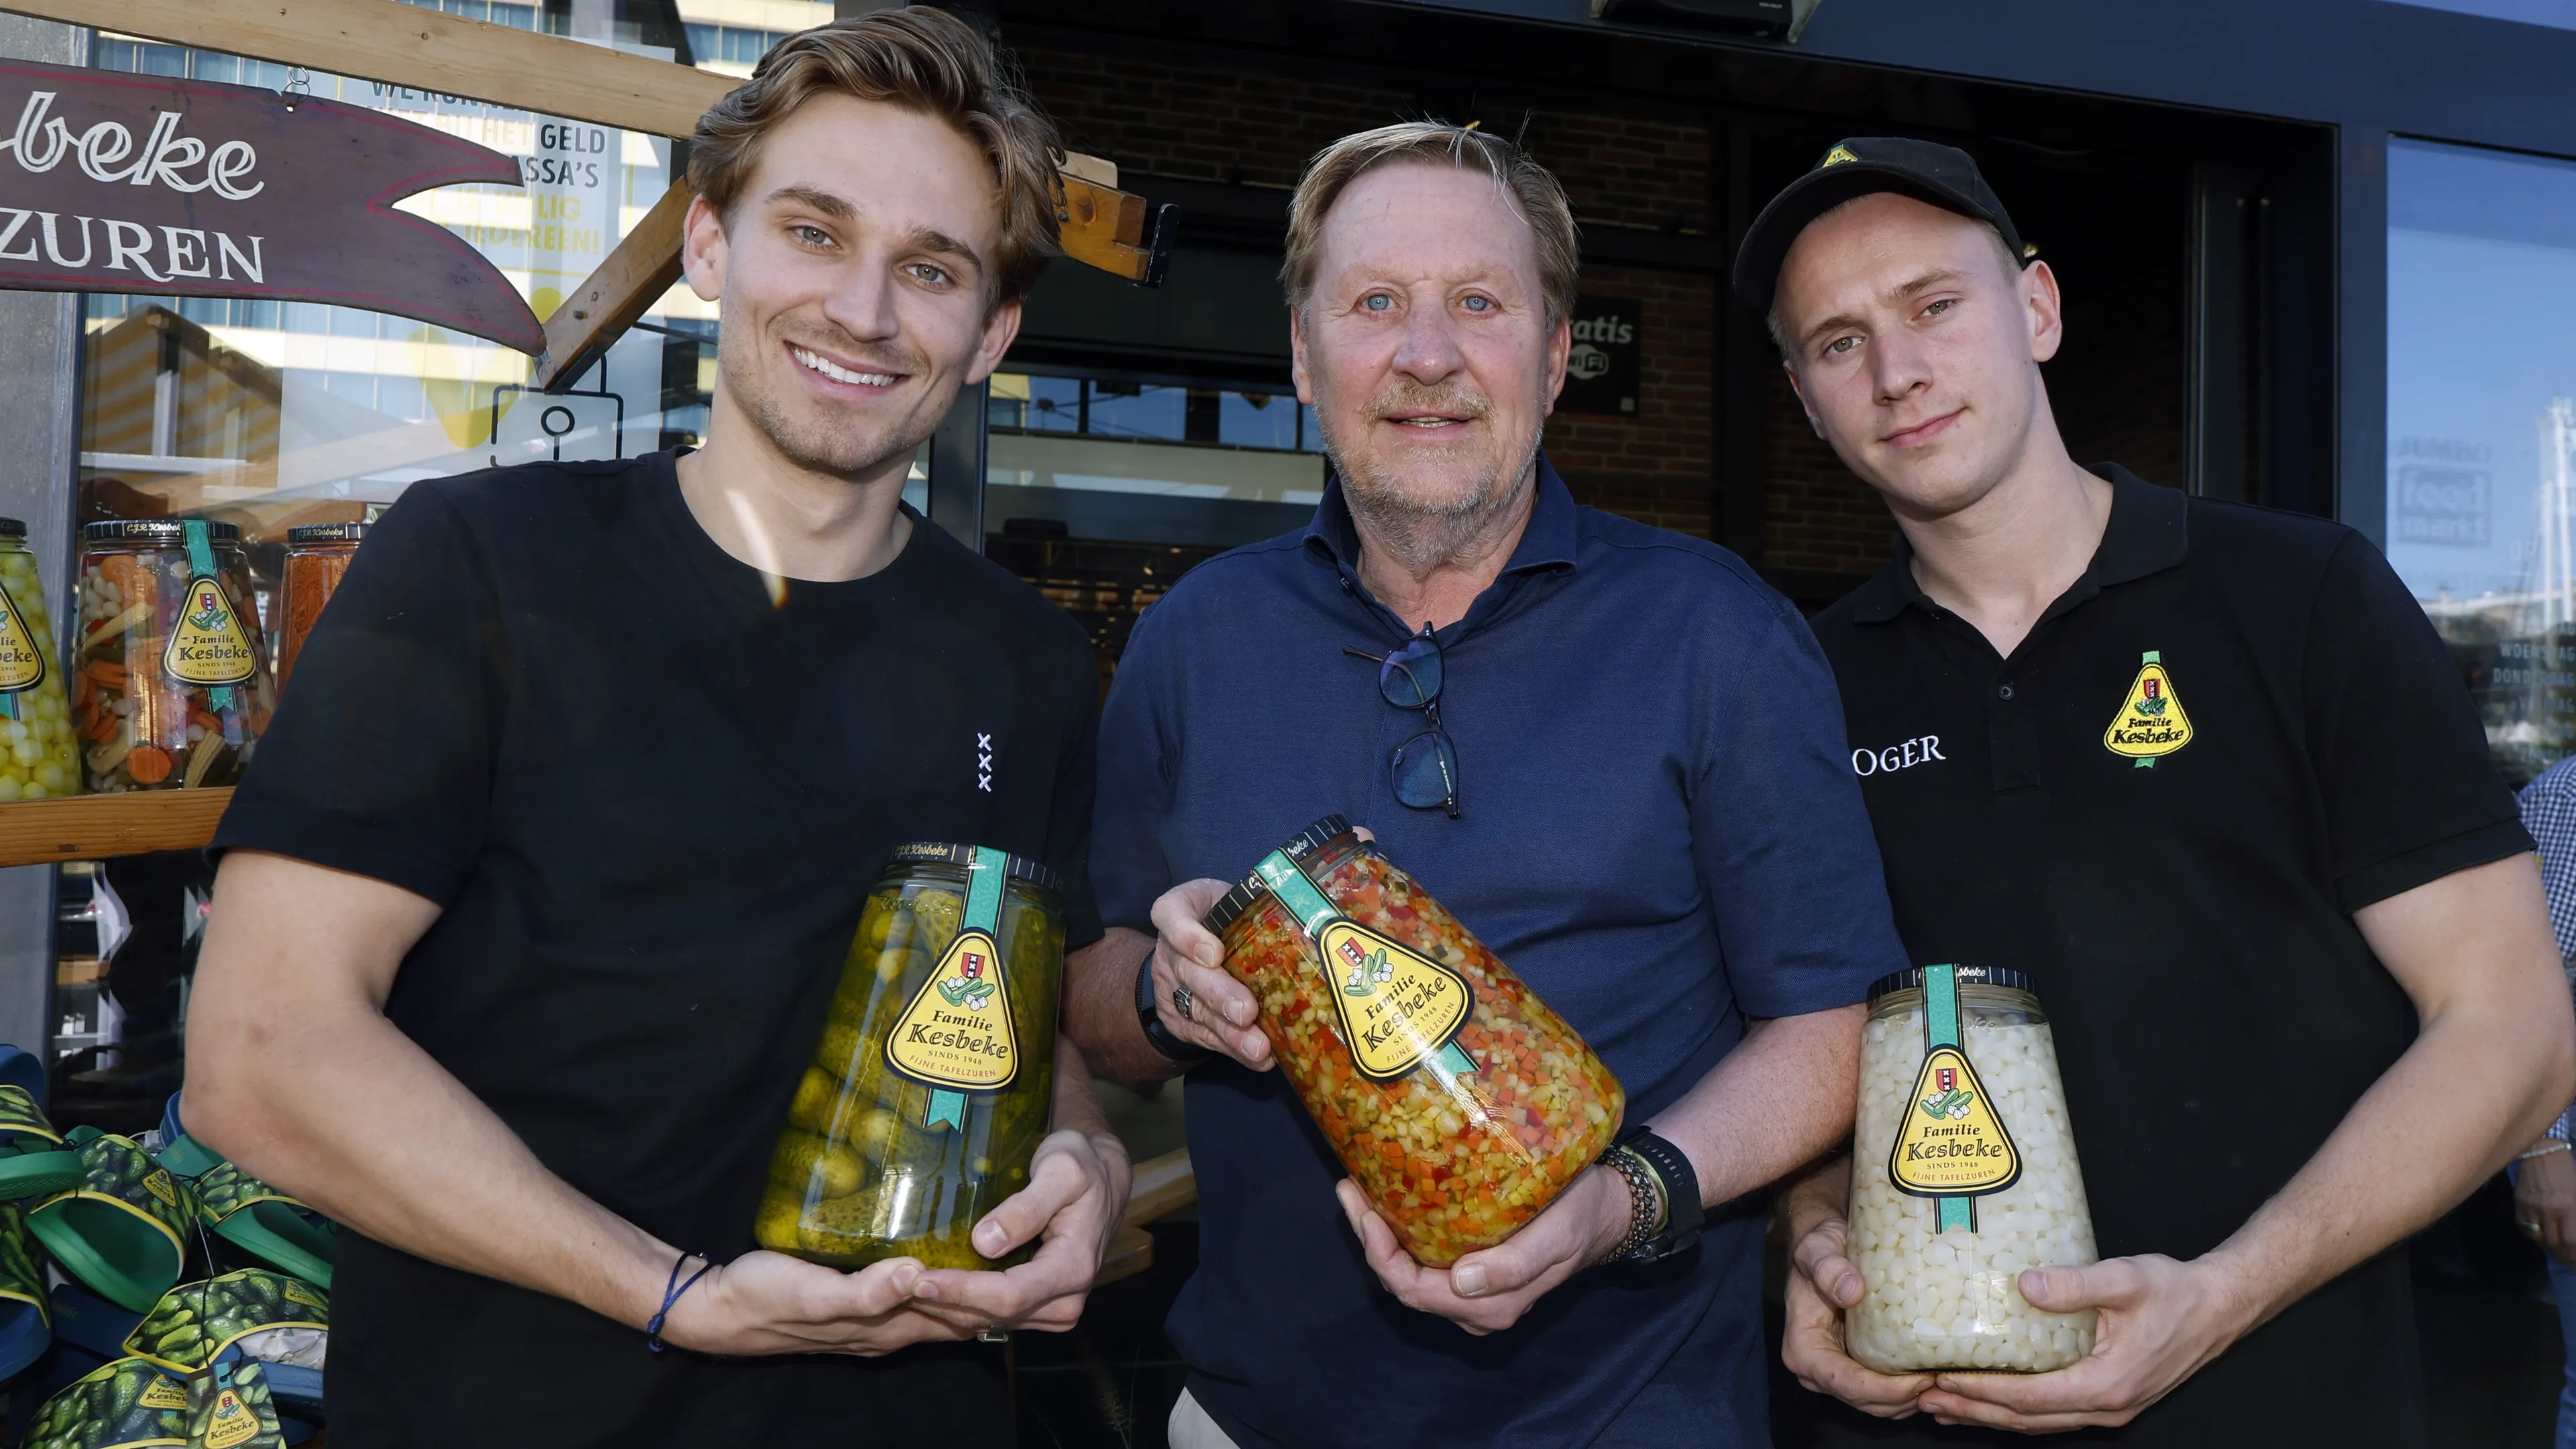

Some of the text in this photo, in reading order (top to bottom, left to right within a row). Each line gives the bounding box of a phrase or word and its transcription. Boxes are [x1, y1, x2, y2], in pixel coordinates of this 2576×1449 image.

[0, 91, 264, 201] beke
[540, 124, 605, 154] GELD
[512, 156, 599, 189] SSA'S
[0, 207, 264, 284] ZUREN
[1570, 315, 1633, 344] atis
[148, 523, 182, 531] Kesbek
[193, 635, 235, 644] Familie
[0, 648, 32, 662] eke
[178, 645, 248, 661] Kesbeke
[2128, 718, 2172, 728] Familie
[2112, 729, 2184, 744] Kesbeke
[910, 844, 948, 857] Kesbeke
[1957, 967, 1986, 978] sbeke
[1364, 974, 1416, 1020] Familie
[931, 1010, 993, 1032] Familie
[1361, 975, 1447, 1053] Kesbeke
[1393, 1006, 1438, 1046] SINDS 1948
[906, 1023, 1009, 1059] Kesbeke
[928, 1050, 983, 1065] SINDS 1948
[1387, 1045, 1411, 1063] FIJNE
[909, 1055, 997, 1077] FIJNE TAFELZUREN
[1923, 1124, 1981, 1138] Familie
[1906, 1138, 2002, 1162] Kesbeke
[1913, 1169, 1996, 1181] FIJNE TAFELZUREN
[1927, 1162, 1955, 1170] SINDS
[145, 1393, 186, 1401] Kesbek
[209, 1420, 254, 1440] Kesbeke
